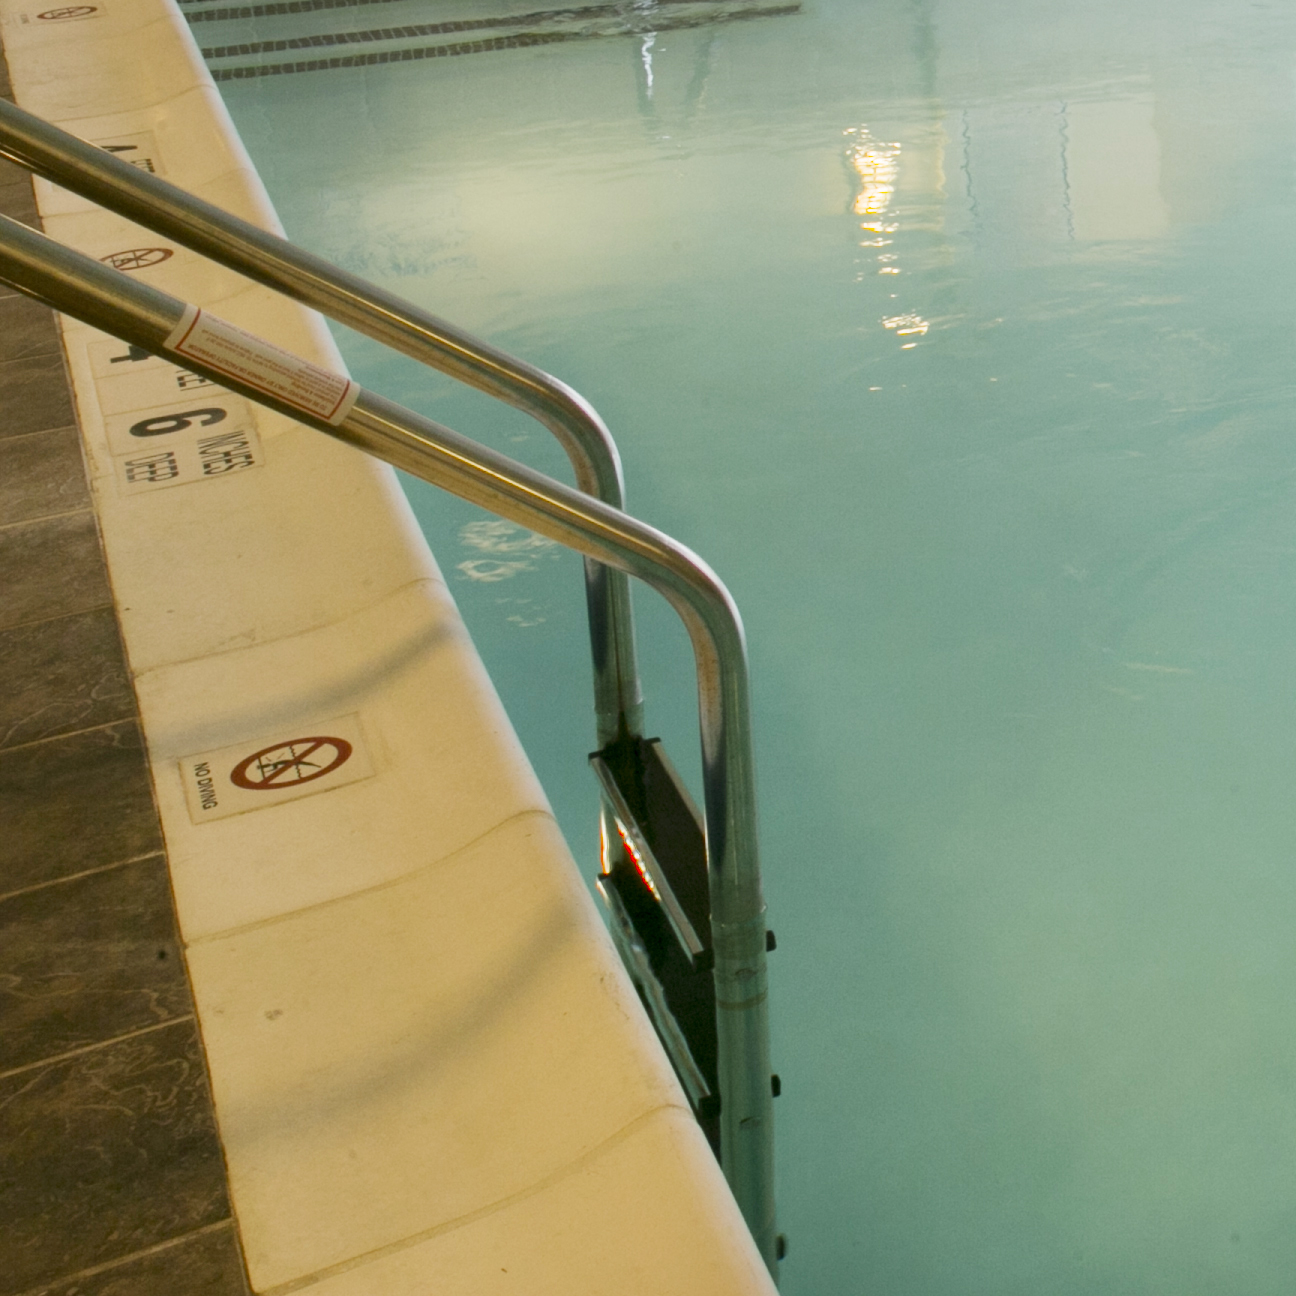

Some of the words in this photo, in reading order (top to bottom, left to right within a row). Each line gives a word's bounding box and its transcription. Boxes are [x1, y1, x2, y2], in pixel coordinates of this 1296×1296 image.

[129, 407, 227, 438] 6
[124, 452, 179, 483] DEEP
[197, 430, 254, 475] INCHES
[194, 762, 211, 778] NO
[196, 777, 218, 810] DIVING
